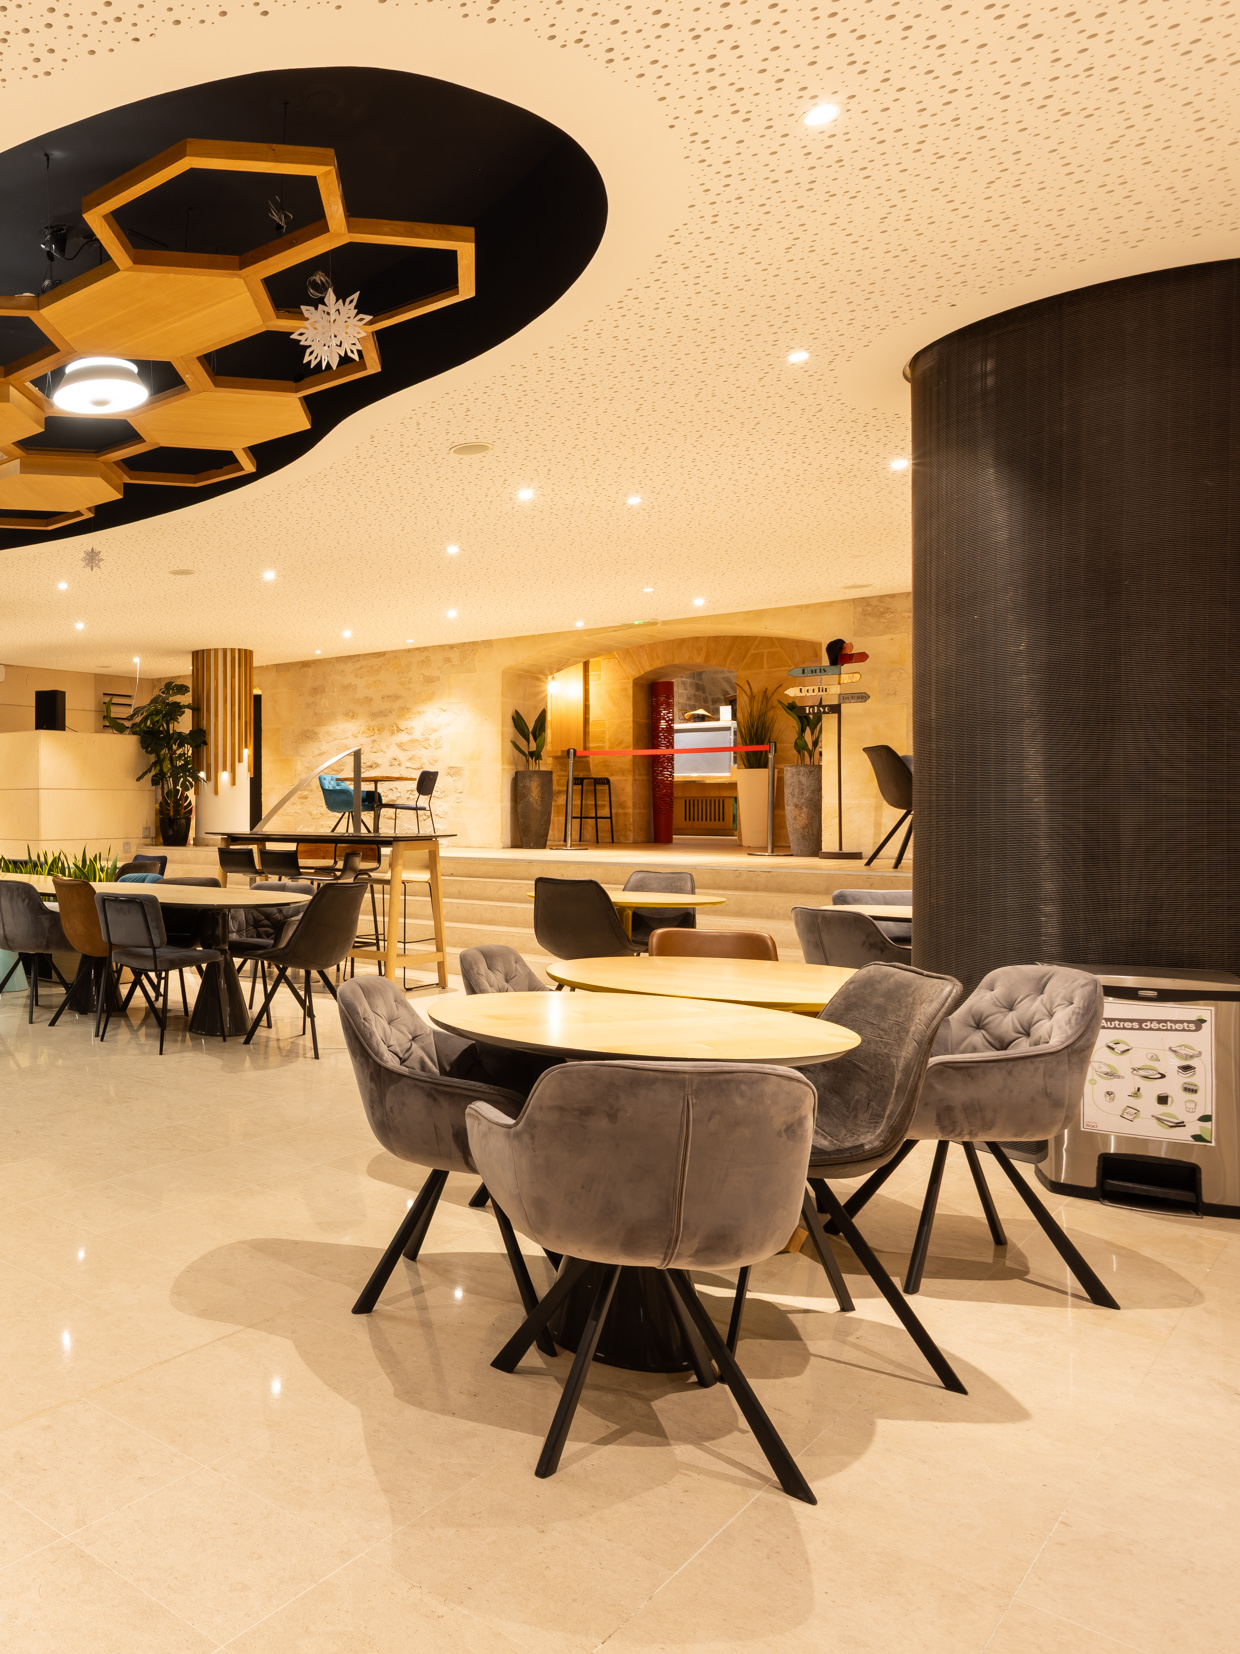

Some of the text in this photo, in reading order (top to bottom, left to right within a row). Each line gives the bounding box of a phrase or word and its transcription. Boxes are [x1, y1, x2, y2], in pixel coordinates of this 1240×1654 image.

[804, 705, 831, 714] Tokyo
[1101, 1019, 1196, 1031] Autres déchets
